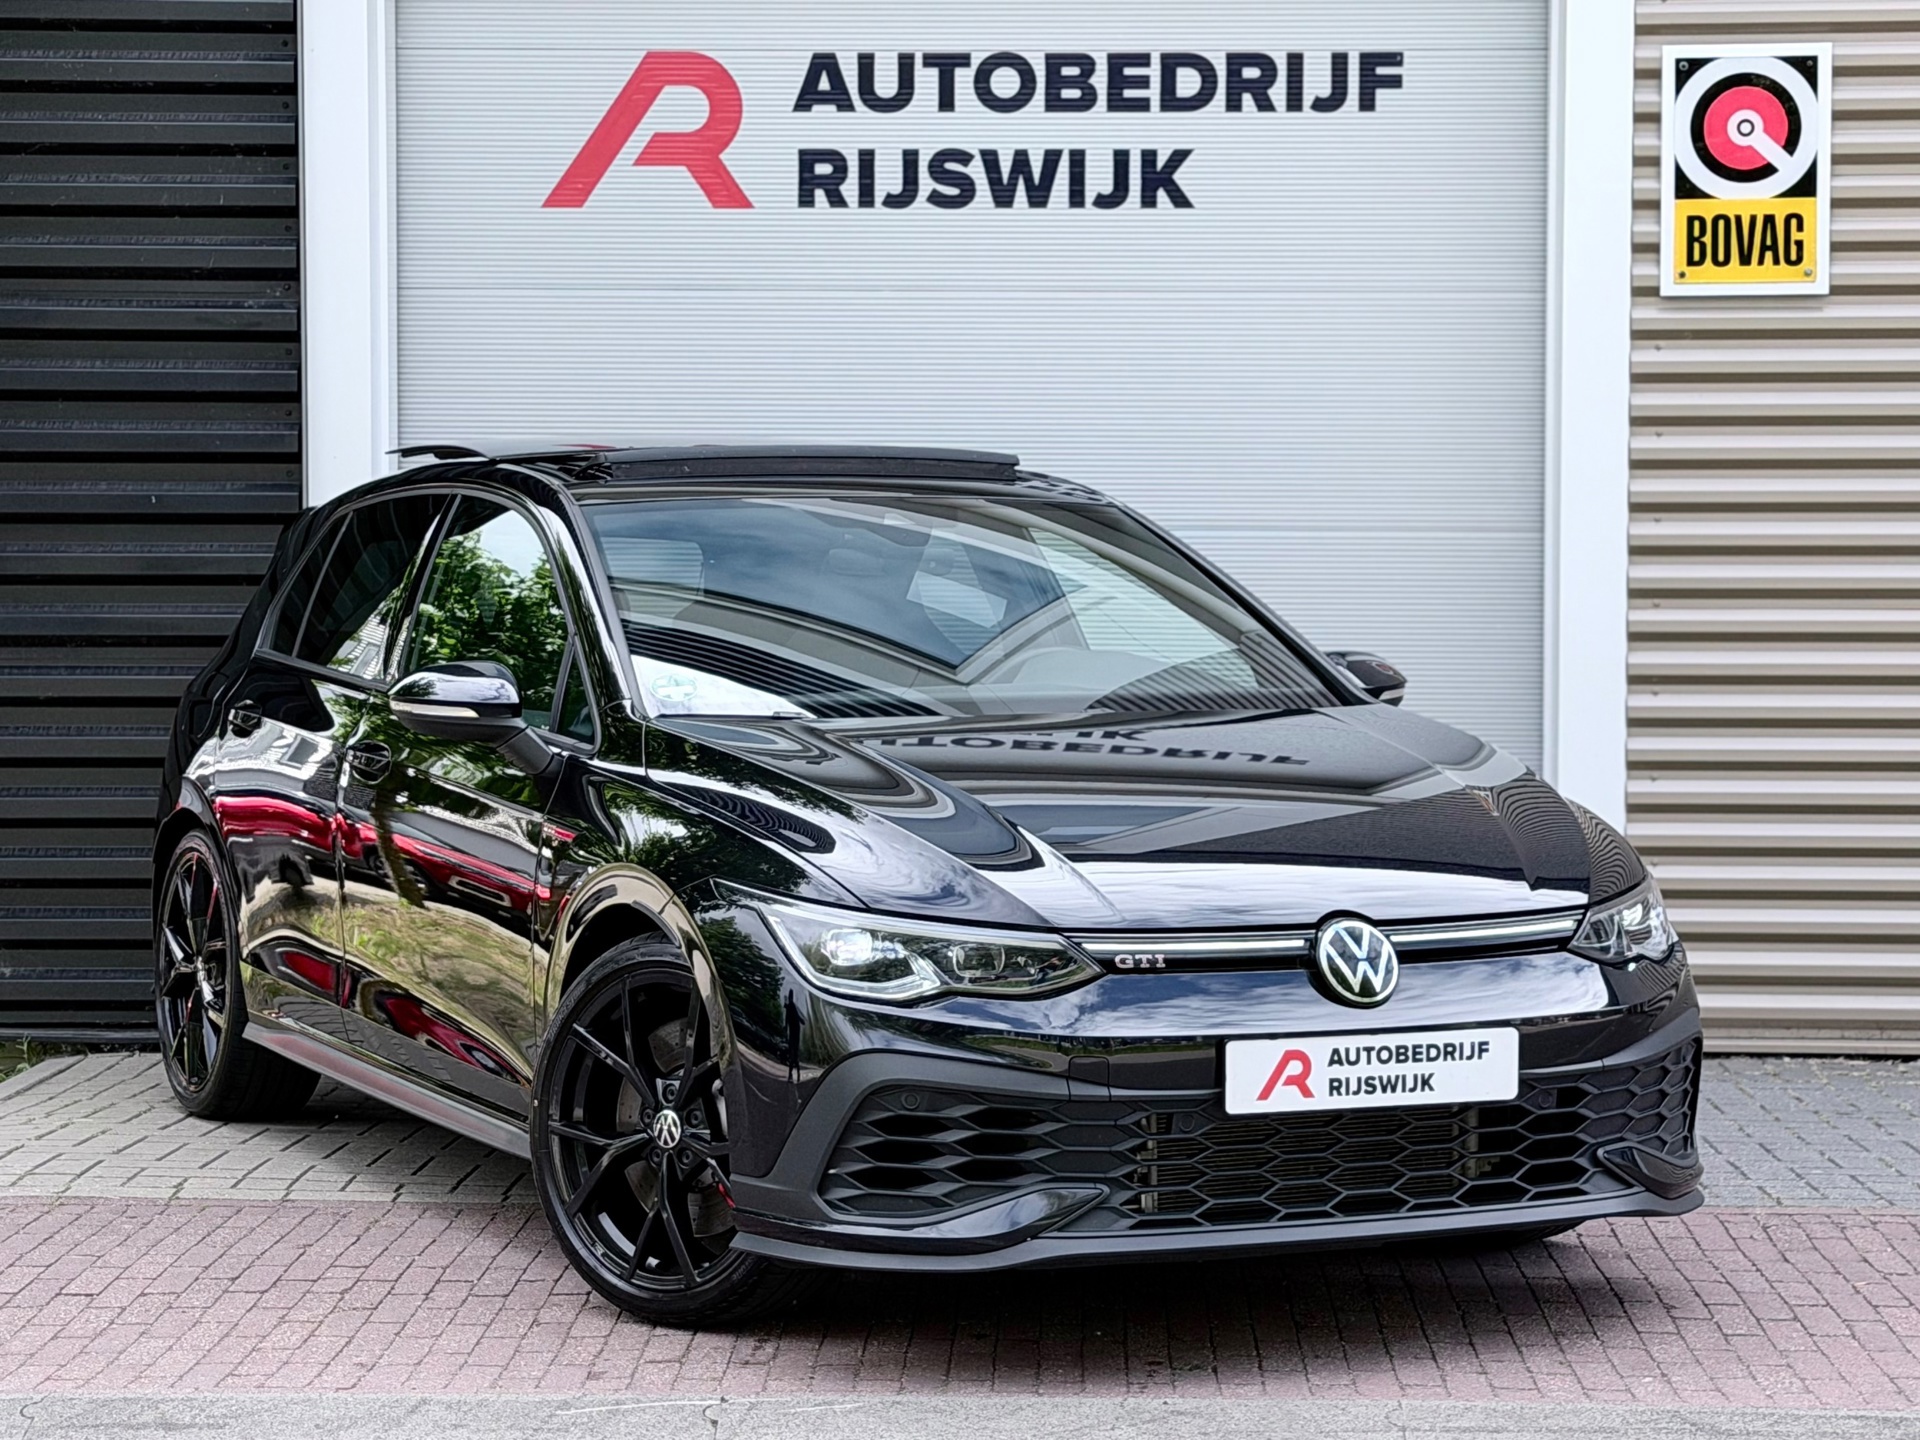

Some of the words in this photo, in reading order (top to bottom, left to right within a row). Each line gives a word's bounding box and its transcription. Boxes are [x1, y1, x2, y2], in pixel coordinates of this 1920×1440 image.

[793, 51, 1403, 113] AUTOBEDRIJF
[798, 148, 1195, 209] RIJSWIJK
[1686, 212, 1805, 268] BOVAG
[1115, 953, 1166, 969] GTI
[1327, 1040, 1490, 1067] AUTOBEDRIJF
[1328, 1073, 1435, 1097] RIJSWIJK
